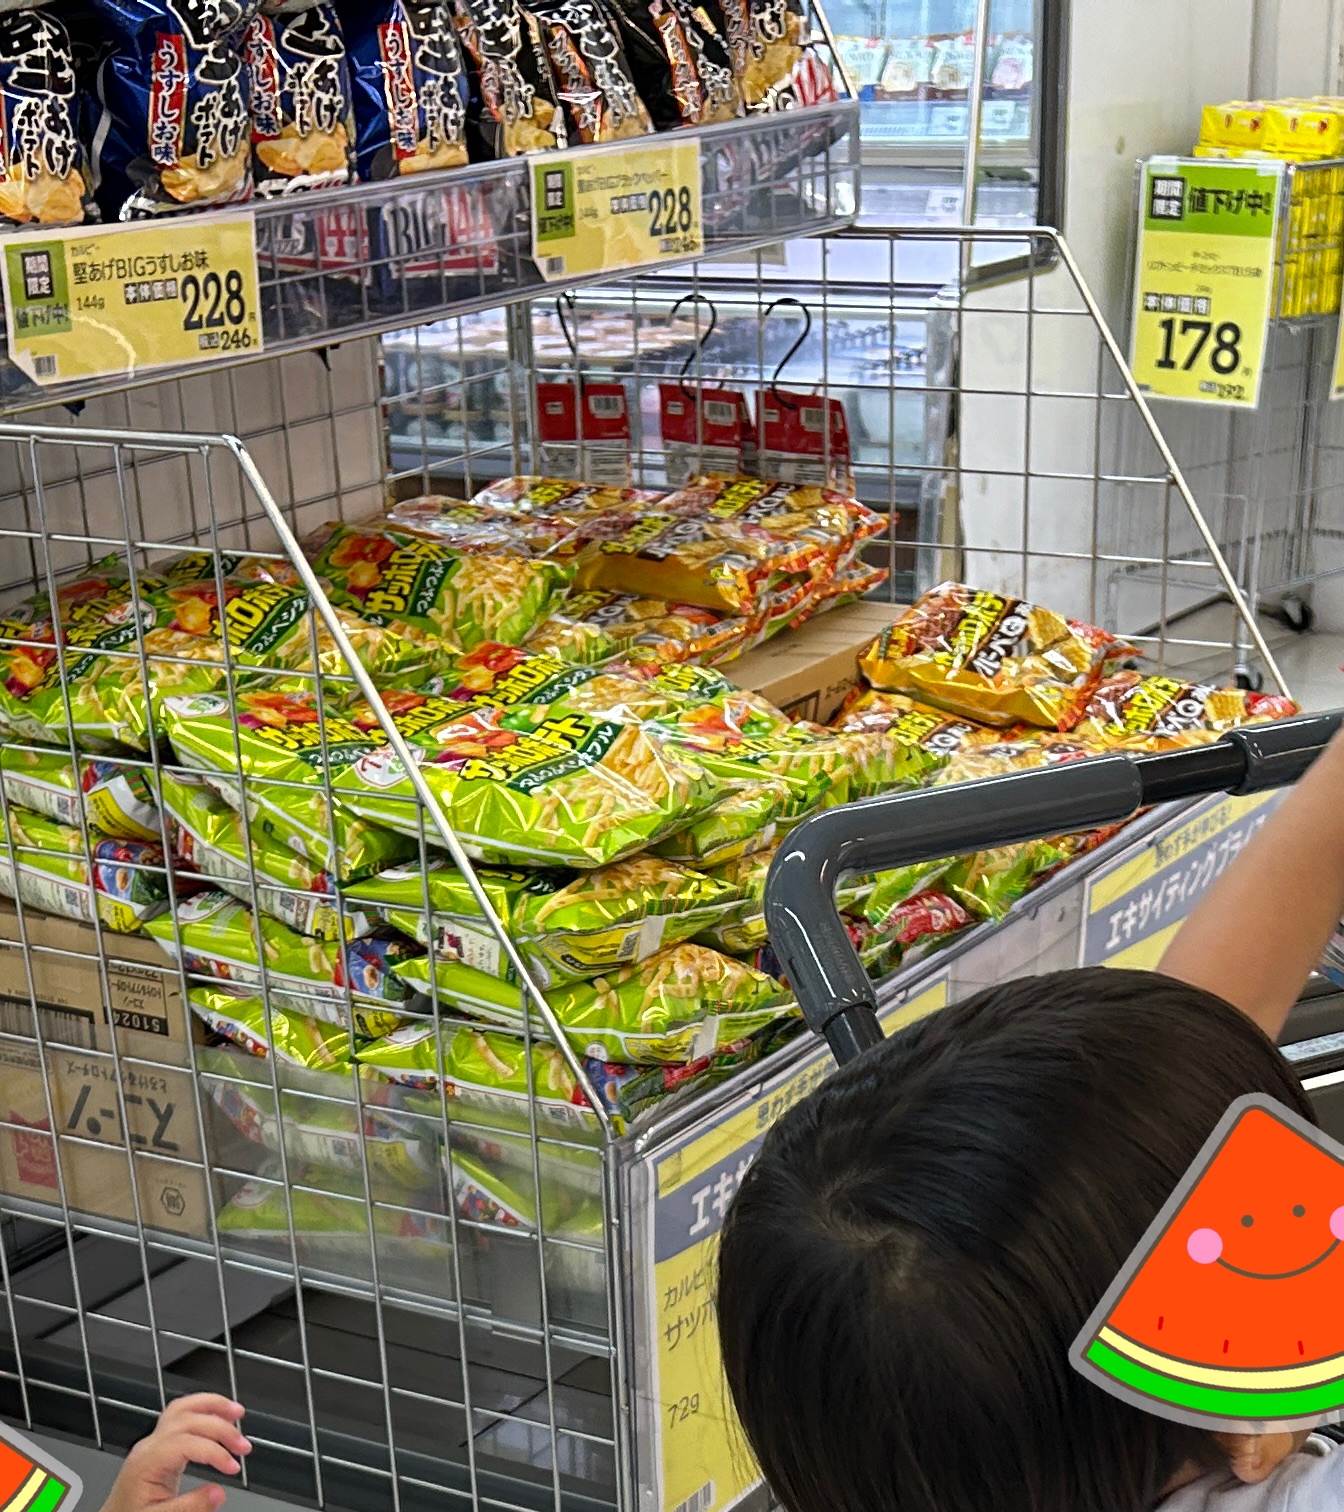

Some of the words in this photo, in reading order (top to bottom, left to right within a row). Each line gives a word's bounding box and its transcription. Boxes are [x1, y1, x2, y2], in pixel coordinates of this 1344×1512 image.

[152, 38, 185, 166] うすしお味
[648, 186, 693, 238] 228
[181, 269, 246, 331] 228
[221, 329, 252, 351] 246
[1156, 317, 1241, 376] 178
